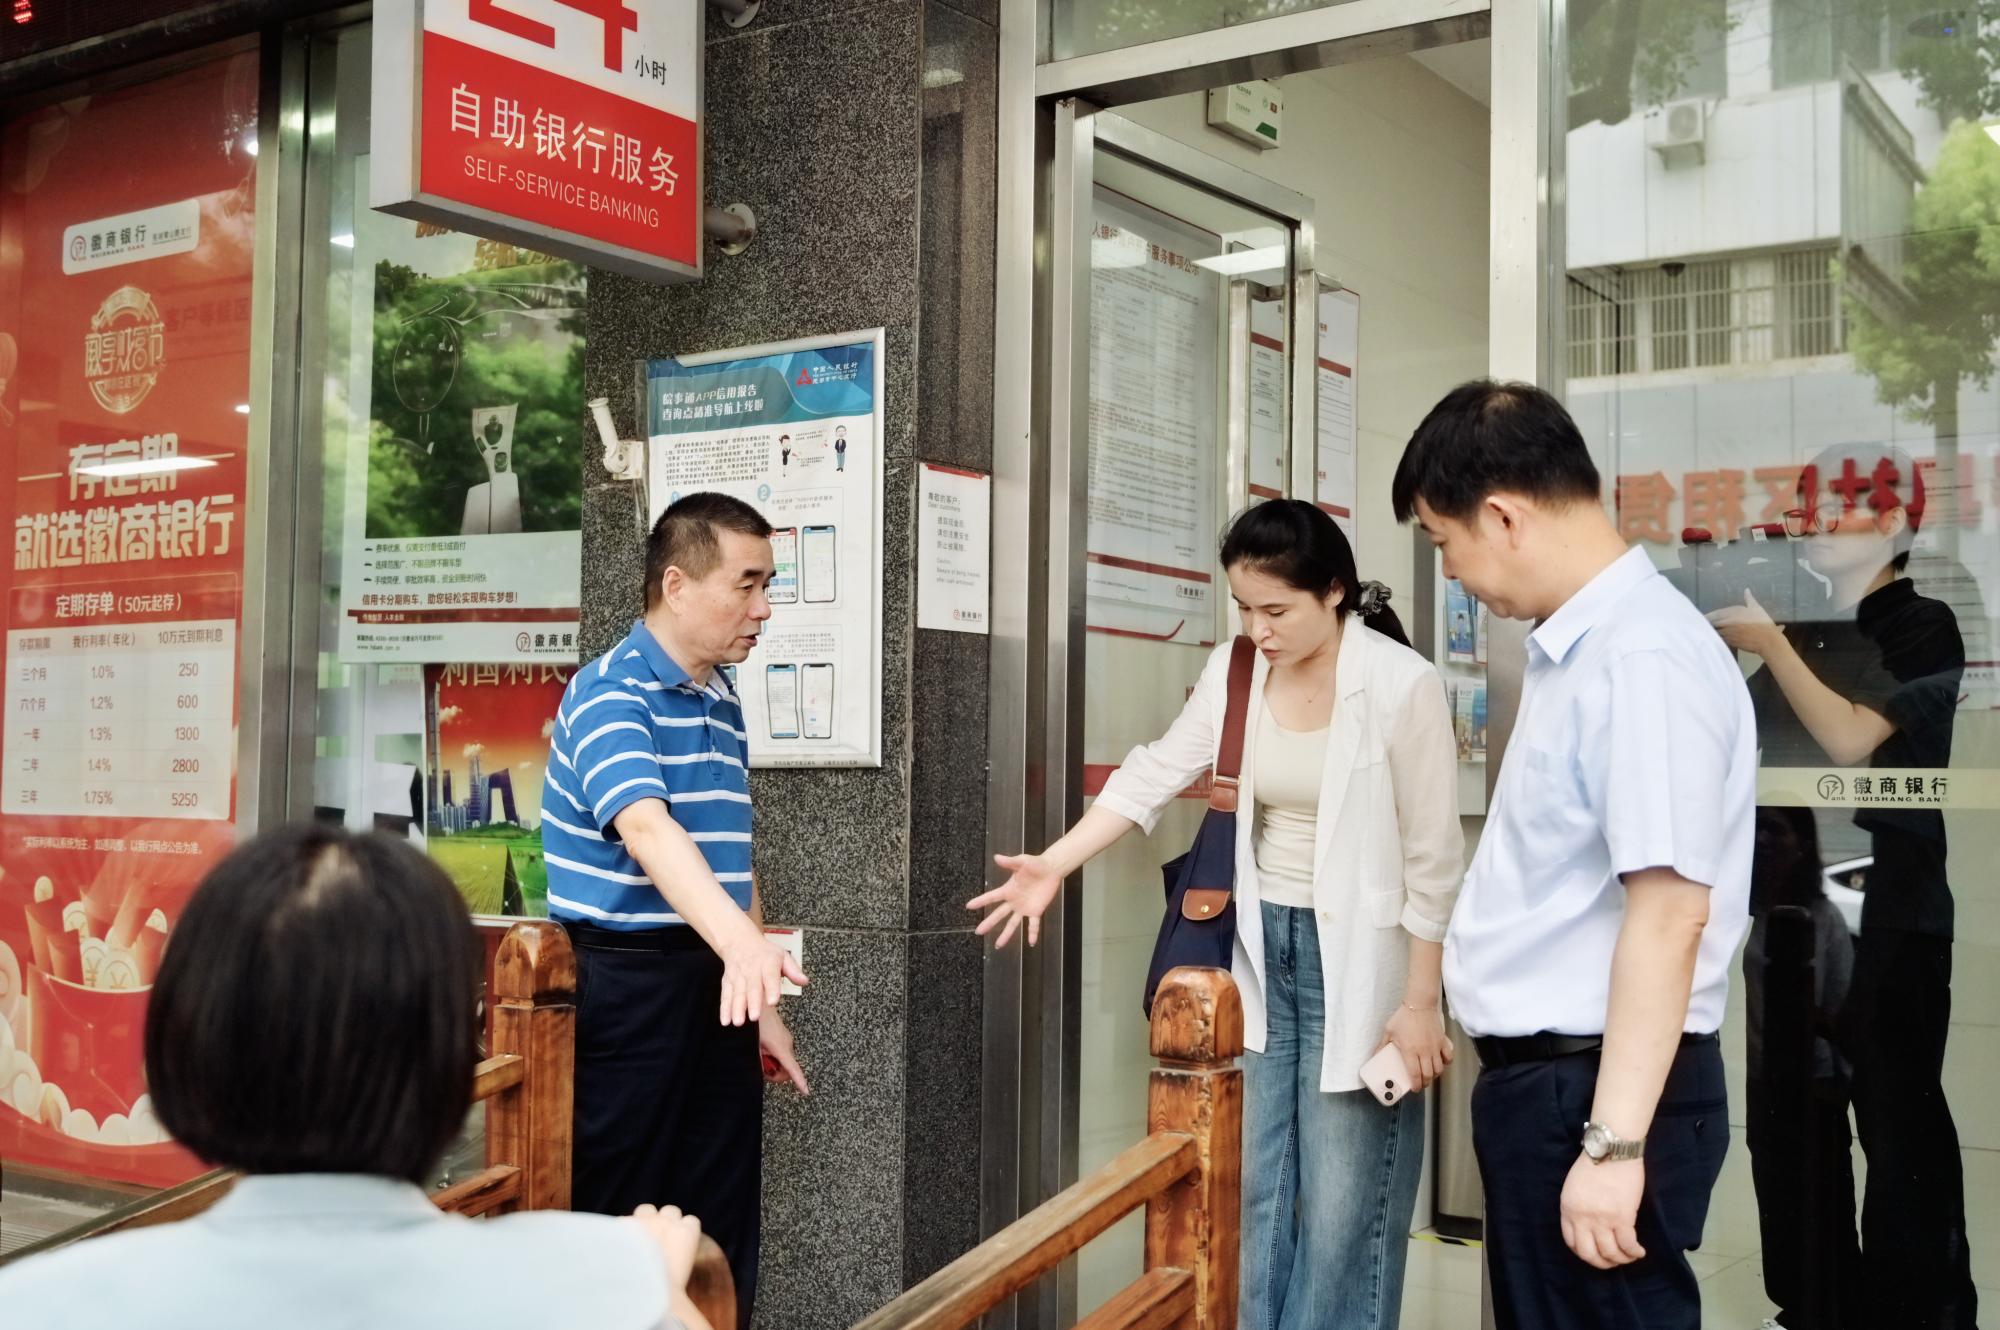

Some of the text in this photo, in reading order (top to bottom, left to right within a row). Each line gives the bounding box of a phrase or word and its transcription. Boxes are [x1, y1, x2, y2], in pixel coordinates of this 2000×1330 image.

[634, 54, 668, 86] 小时
[450, 82, 680, 197] 自助银行服务
[464, 155, 660, 228] SELF-SERVICE BANKING
[91, 225, 147, 252] 徽商银行
[662, 383, 758, 406] 皖事通APP信用报告
[662, 398, 764, 421] 查询点精准导航上线啦
[68, 432, 179, 501] 存定期
[14, 493, 235, 570] 就选徽商银行
[55, 591, 182, 618] 定期存单（50元起存）
[158, 628, 224, 645] 10万元到期利息
[21, 662, 199, 682] 三个月 1.0% 250
[20, 694, 199, 712] 六个月 1.2% 600
[23, 726, 200, 742] 一年 1.3% 1300
[22, 757, 200, 774] 二年 1.4% 2800
[1853, 776, 1948, 795] 徽商银行
[20, 789, 199, 807] 三年 1.75% 5250
